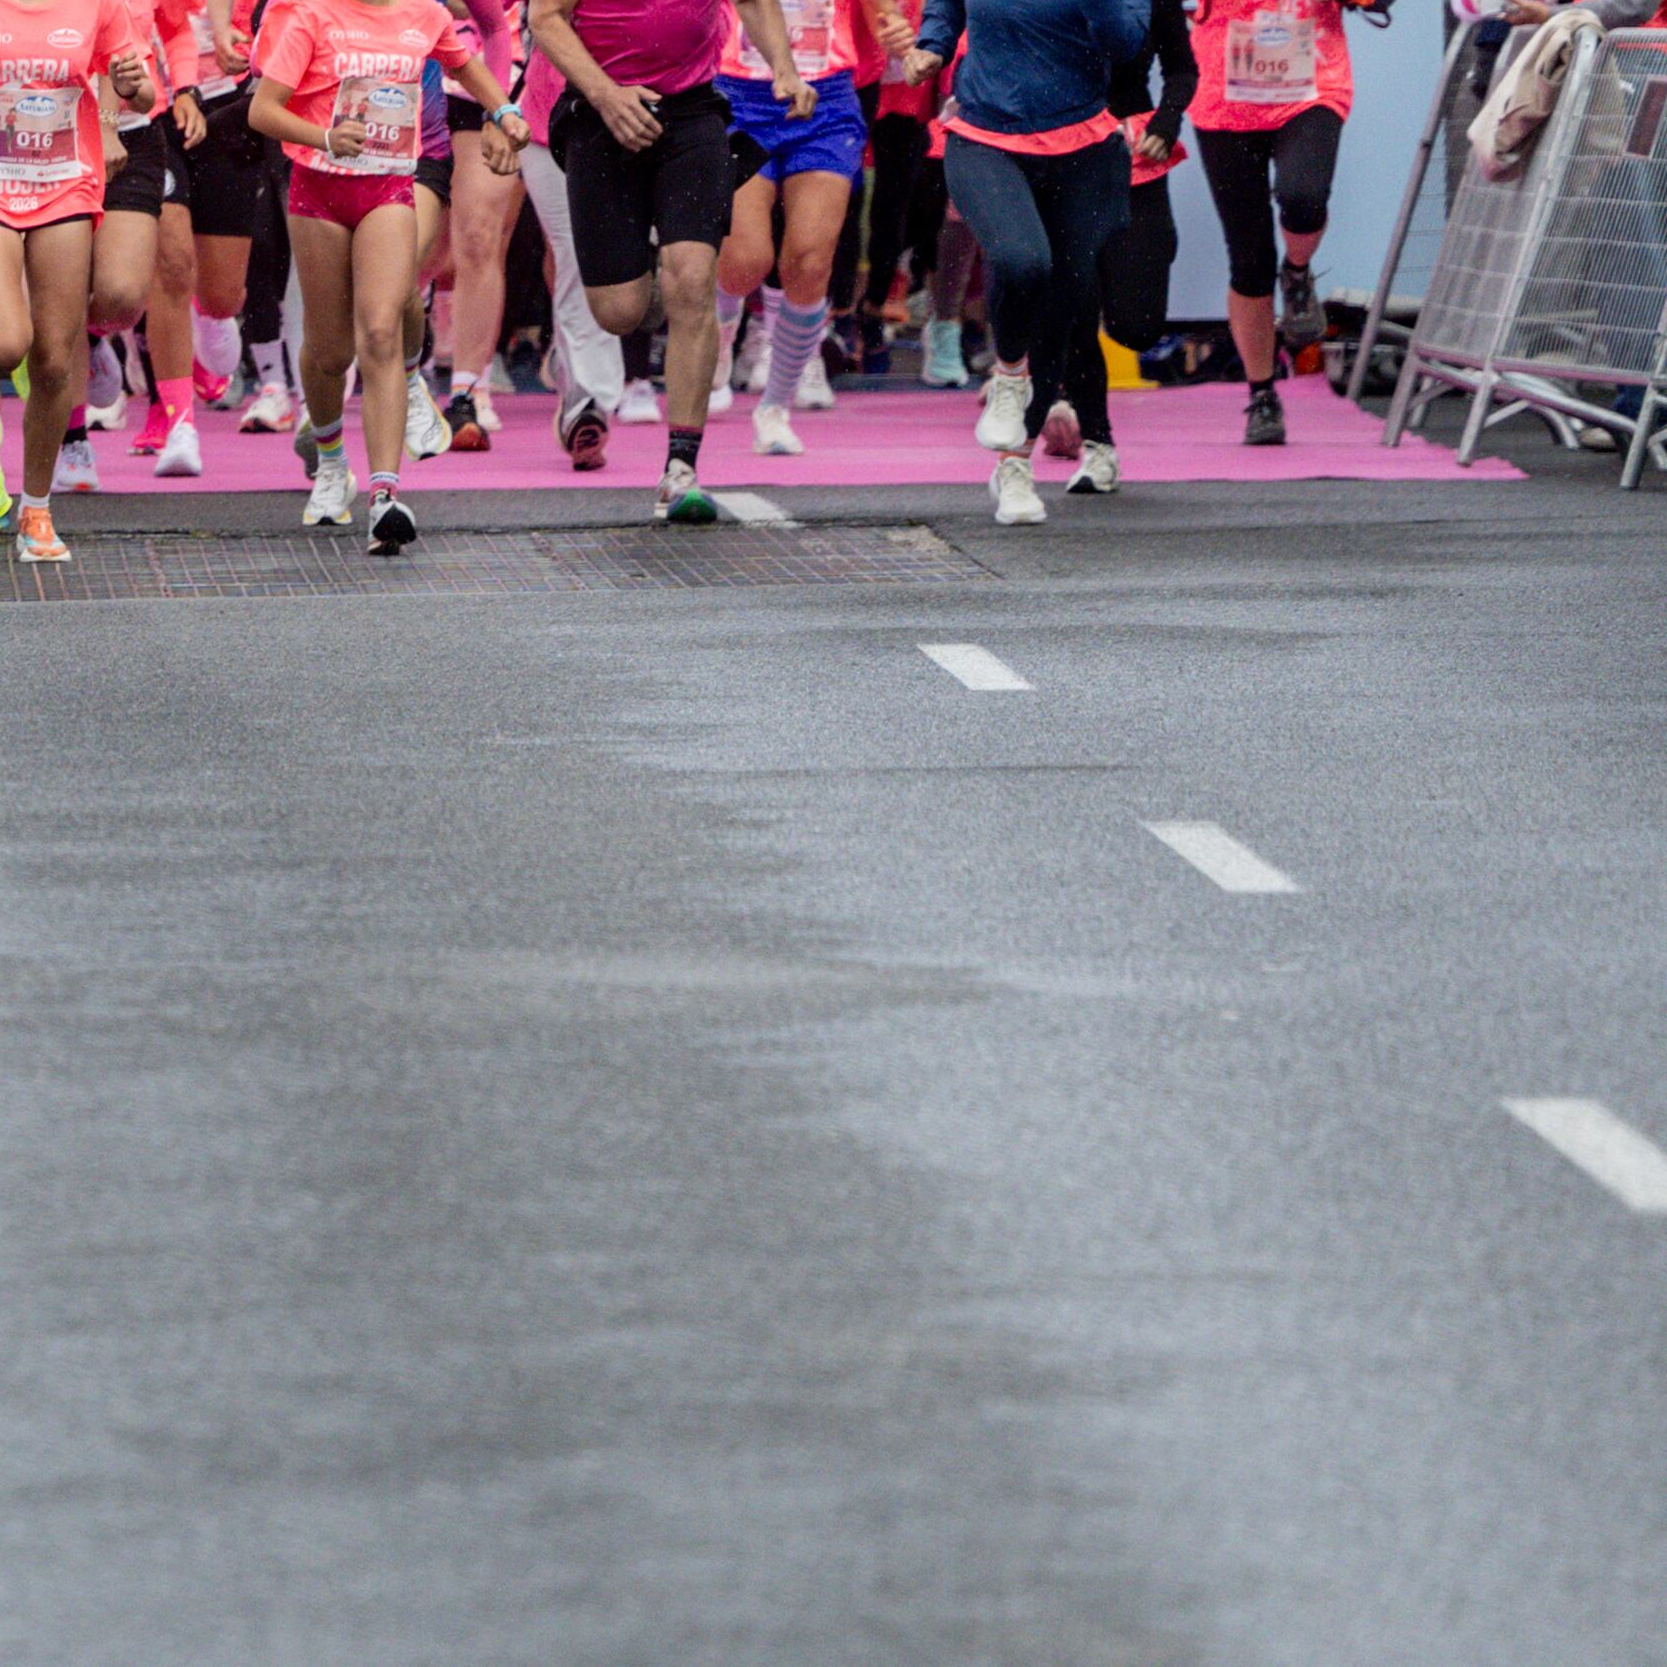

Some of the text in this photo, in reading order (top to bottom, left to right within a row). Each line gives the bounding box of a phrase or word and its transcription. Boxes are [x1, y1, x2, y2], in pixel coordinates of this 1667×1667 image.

[1254, 59, 1289, 74] 016
[16, 132, 54, 148] 016
[365, 122, 400, 142] 016
